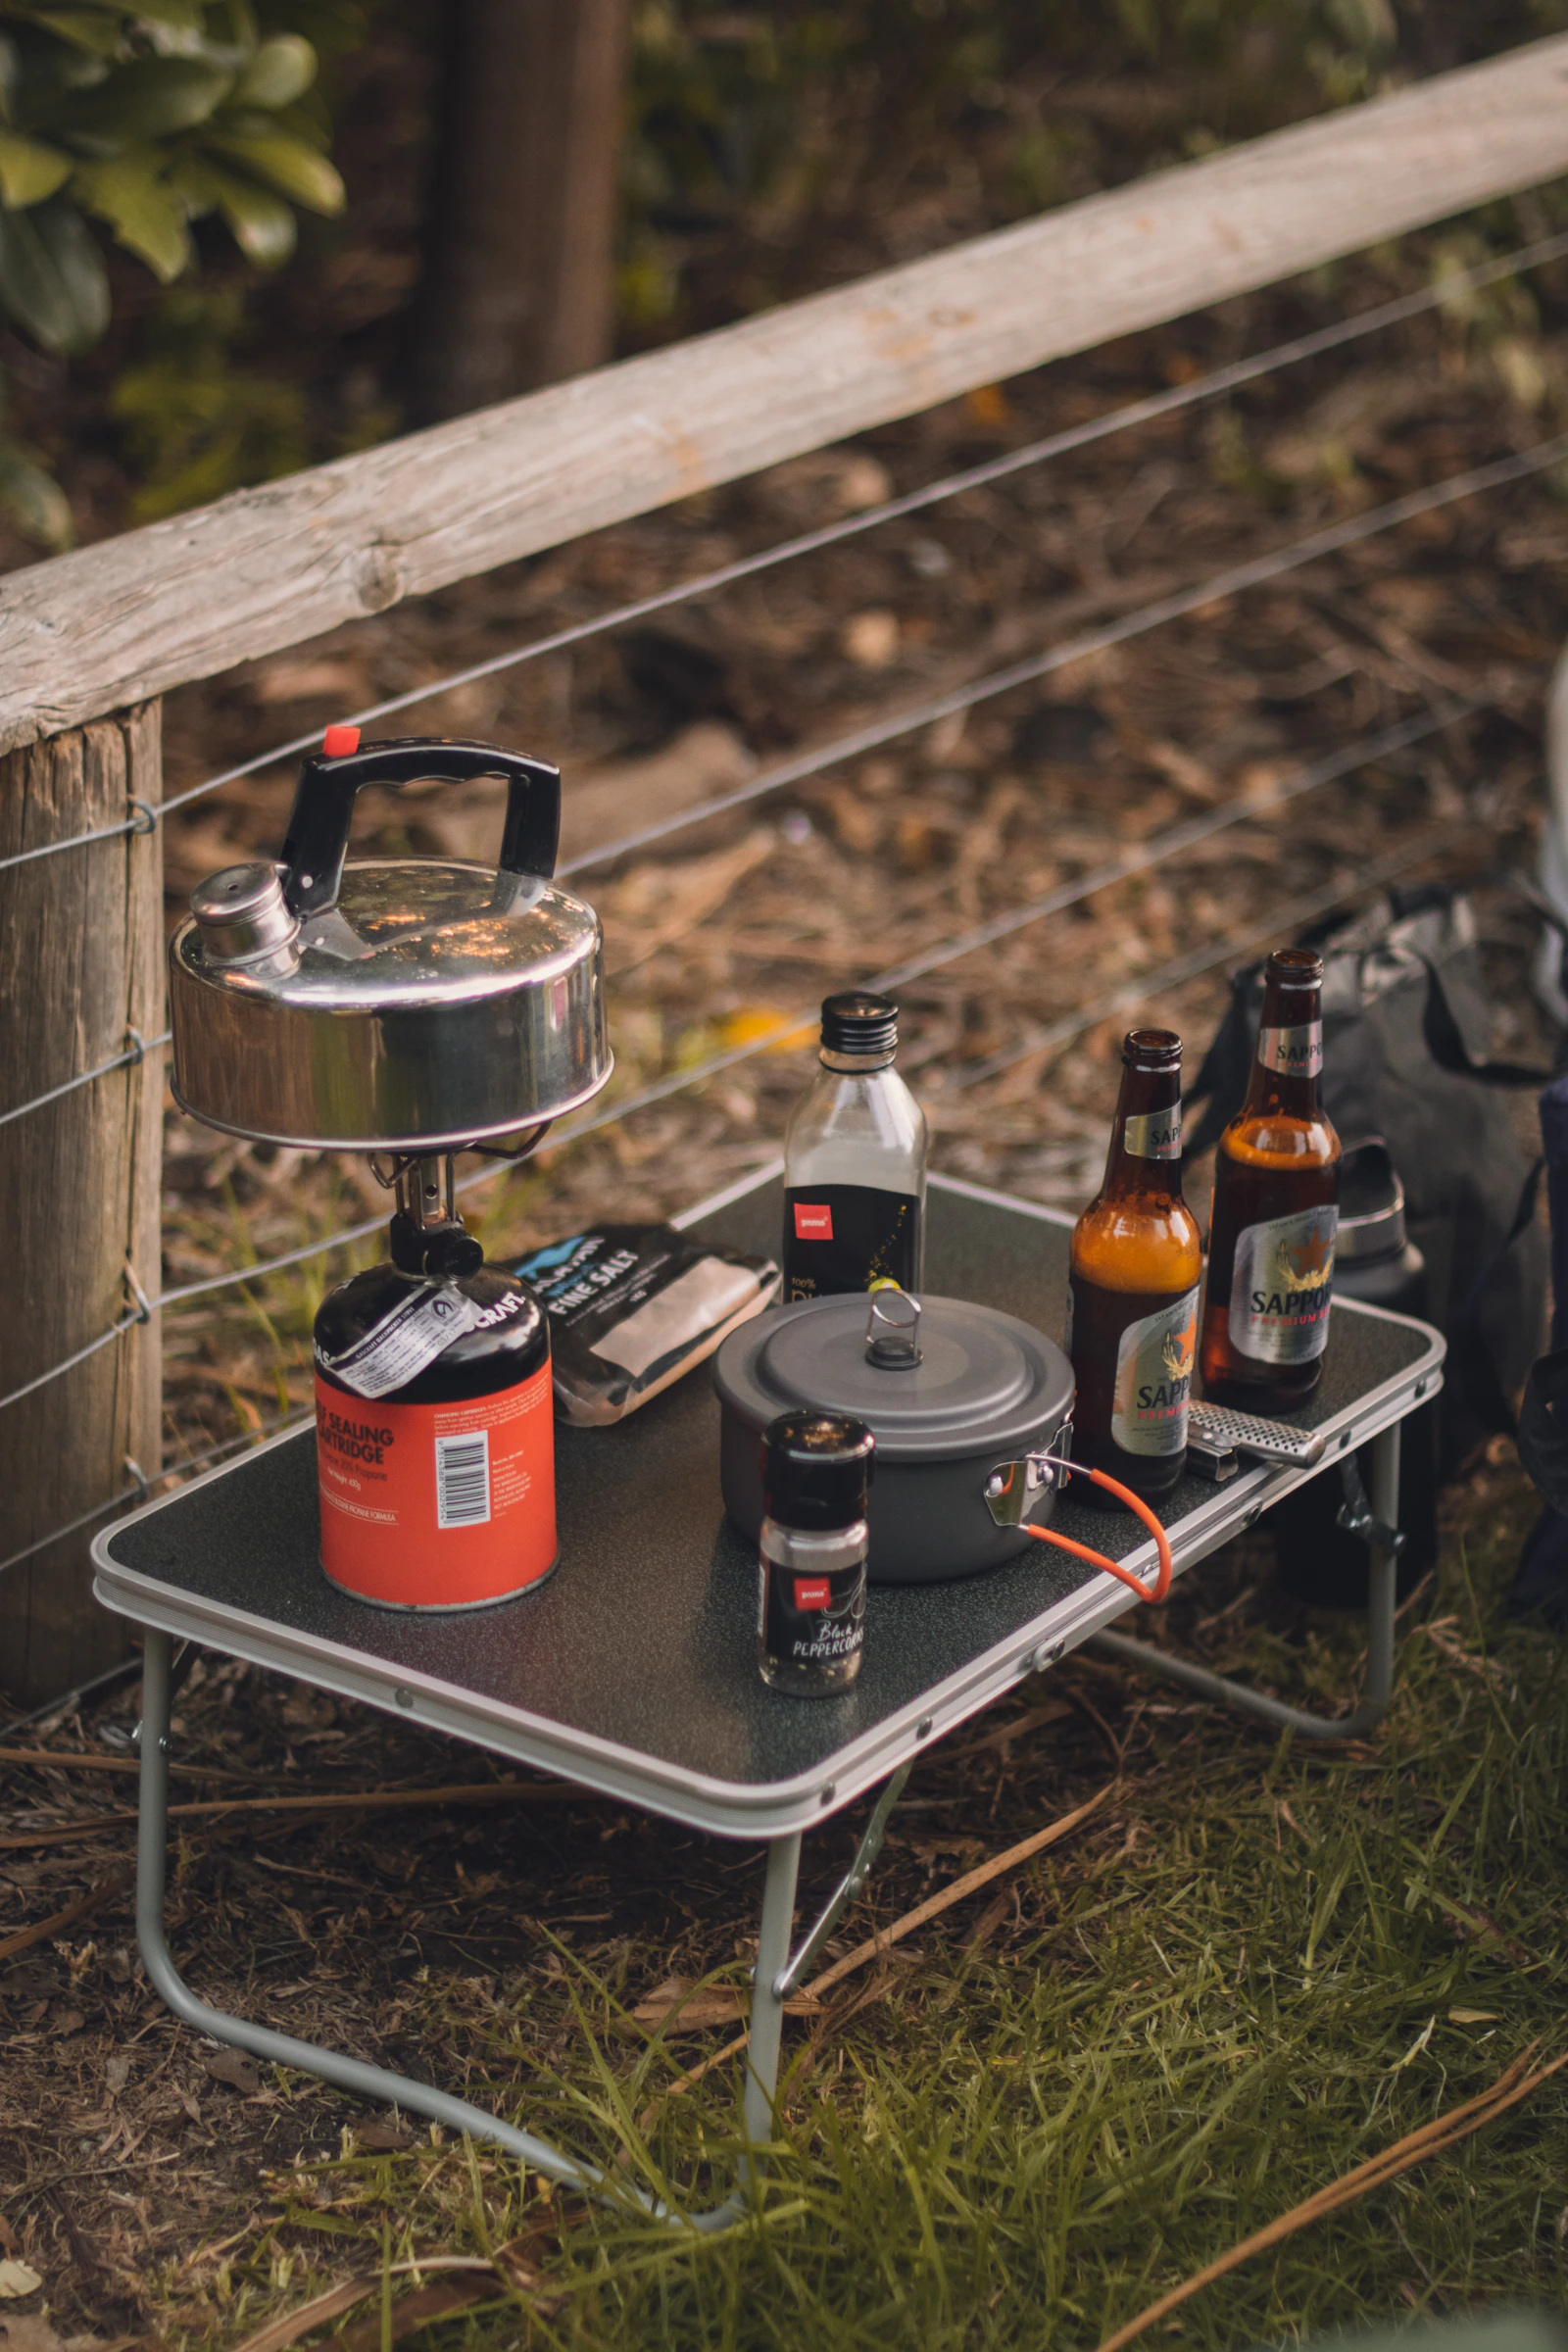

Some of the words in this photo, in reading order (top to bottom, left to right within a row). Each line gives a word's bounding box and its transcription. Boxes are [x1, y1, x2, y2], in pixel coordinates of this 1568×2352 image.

[549, 1282, 599, 1314] FINE
[590, 1250, 639, 1287] SALT
[792, 1277, 816, 1289] 100%
[401, 1306, 416, 1323] STOVE
[1250, 1311, 1316, 1326] PREMIUM
[1137, 1377, 1190, 1409] SAPP
[329, 1412, 395, 1446] SEALING
[369, 1510, 396, 1522] FORMULA
[815, 1619, 853, 1642] Black
